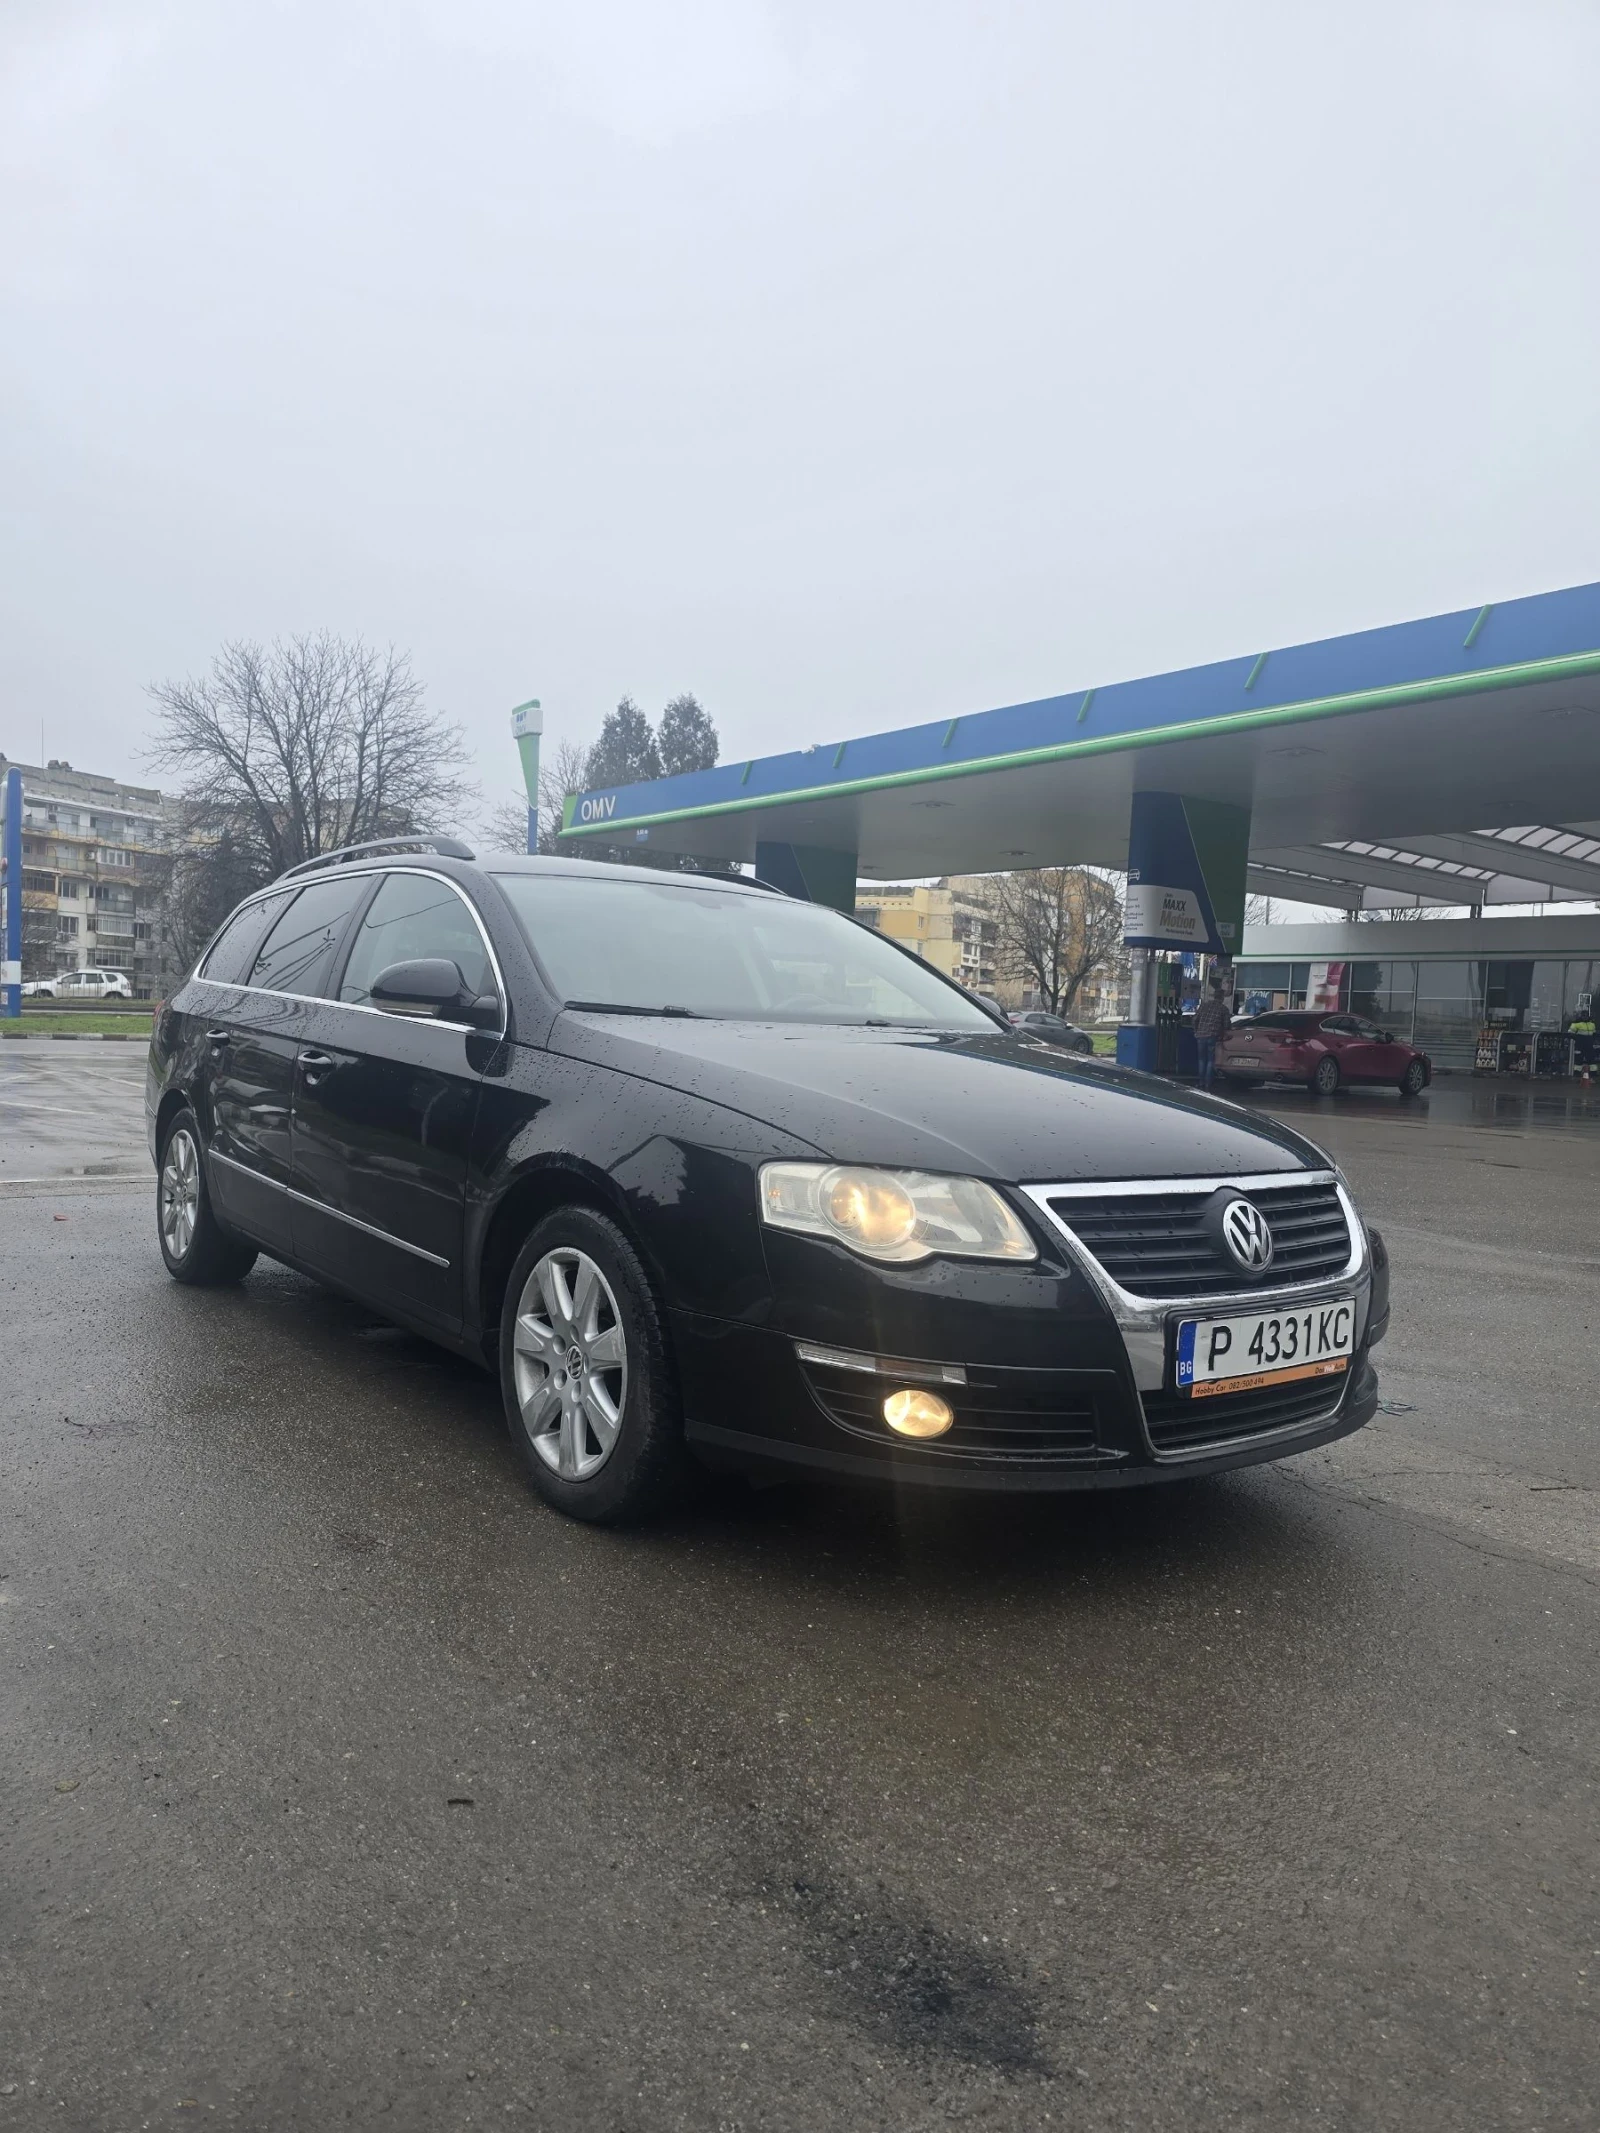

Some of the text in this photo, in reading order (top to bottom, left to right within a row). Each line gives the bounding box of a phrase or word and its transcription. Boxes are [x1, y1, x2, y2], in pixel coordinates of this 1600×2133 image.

[581, 795, 616, 821] OMV
[1162, 898, 1187, 912] MAXX
[1160, 910, 1196, 930] Motion
[1208, 1307, 1350, 1371] P 4331KC
[1180, 1361, 1192, 1376] BG
[1195, 1385, 1214, 1395] Hobby
[1215, 1384, 1227, 1392] Car
